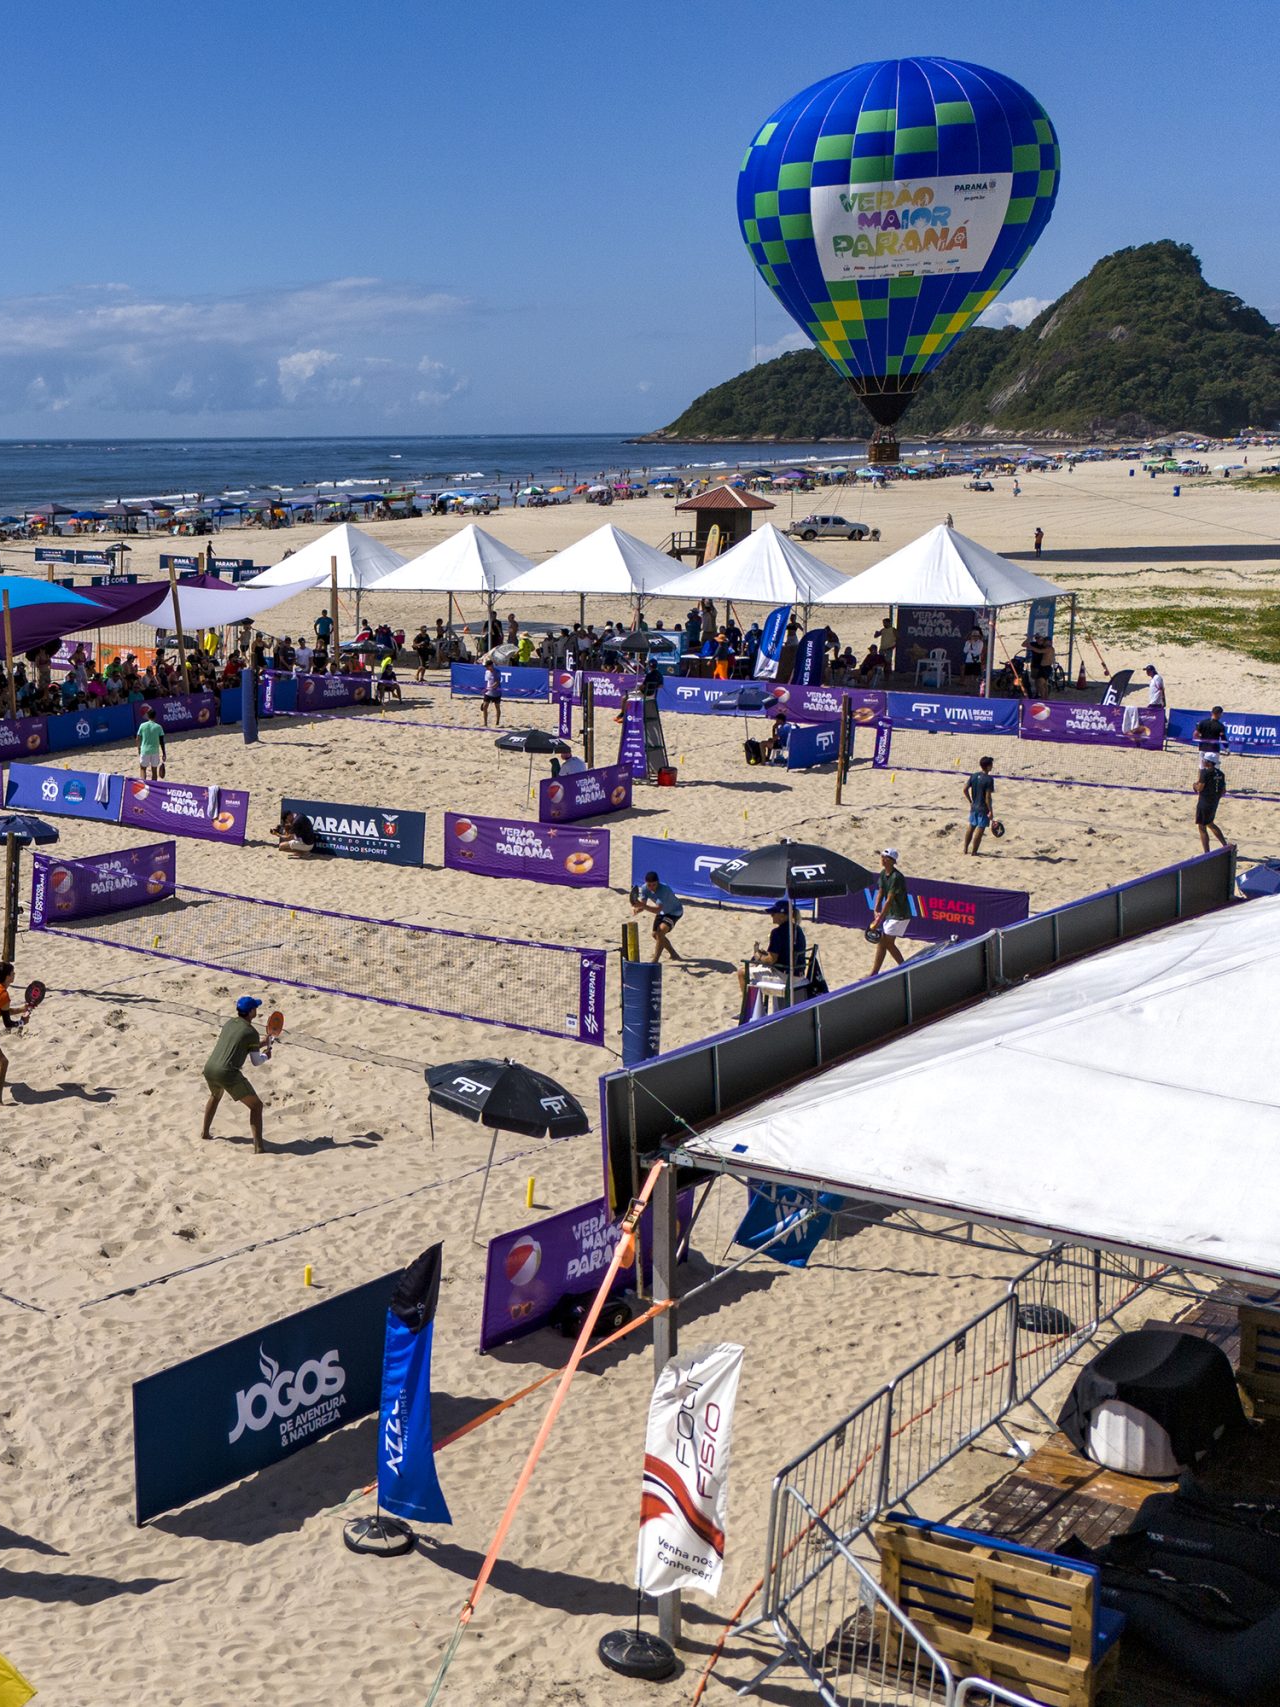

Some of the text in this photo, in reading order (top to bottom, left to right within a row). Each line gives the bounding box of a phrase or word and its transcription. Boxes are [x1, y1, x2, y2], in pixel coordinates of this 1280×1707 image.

[954, 181, 987, 191] PARANÁ
[840, 183, 934, 213] VERÃO
[858, 206, 951, 231] MAIOR
[832, 220, 970, 258] PARANÁ
[677, 686, 700, 699] FPT
[912, 703, 968, 719] FPT VITA
[816, 731, 835, 750] FPT
[1255, 726, 1277, 737] VITA
[42, 782, 58, 797] 90
[167, 787, 193, 798] VERÃO
[161, 801, 205, 819] PARANÁ
[171, 797, 198, 807] MAIOR
[499, 826, 535, 838] VERÃO
[361, 847, 387, 855] ESPORTE
[507, 836, 542, 848] MAIOR
[496, 843, 554, 860] PARANÁ
[727, 858, 749, 872] FPT
[791, 863, 826, 879] FPT
[928, 896, 976, 914] BEACH
[932, 911, 975, 926] SPORTS
[588, 971, 598, 1013] SANEPAR
[452, 1076, 491, 1096] FPT
[540, 1095, 568, 1115] FPT
[229, 1349, 346, 1444] JOGOS
[279, 1395, 347, 1436] DE AVENTURA
[281, 1410, 342, 1447] & NATUREZA
[696, 1402, 721, 1499] FISIO
[657, 1536, 714, 1569] Venha nos
[656, 1551, 713, 1582] Conhecer!
